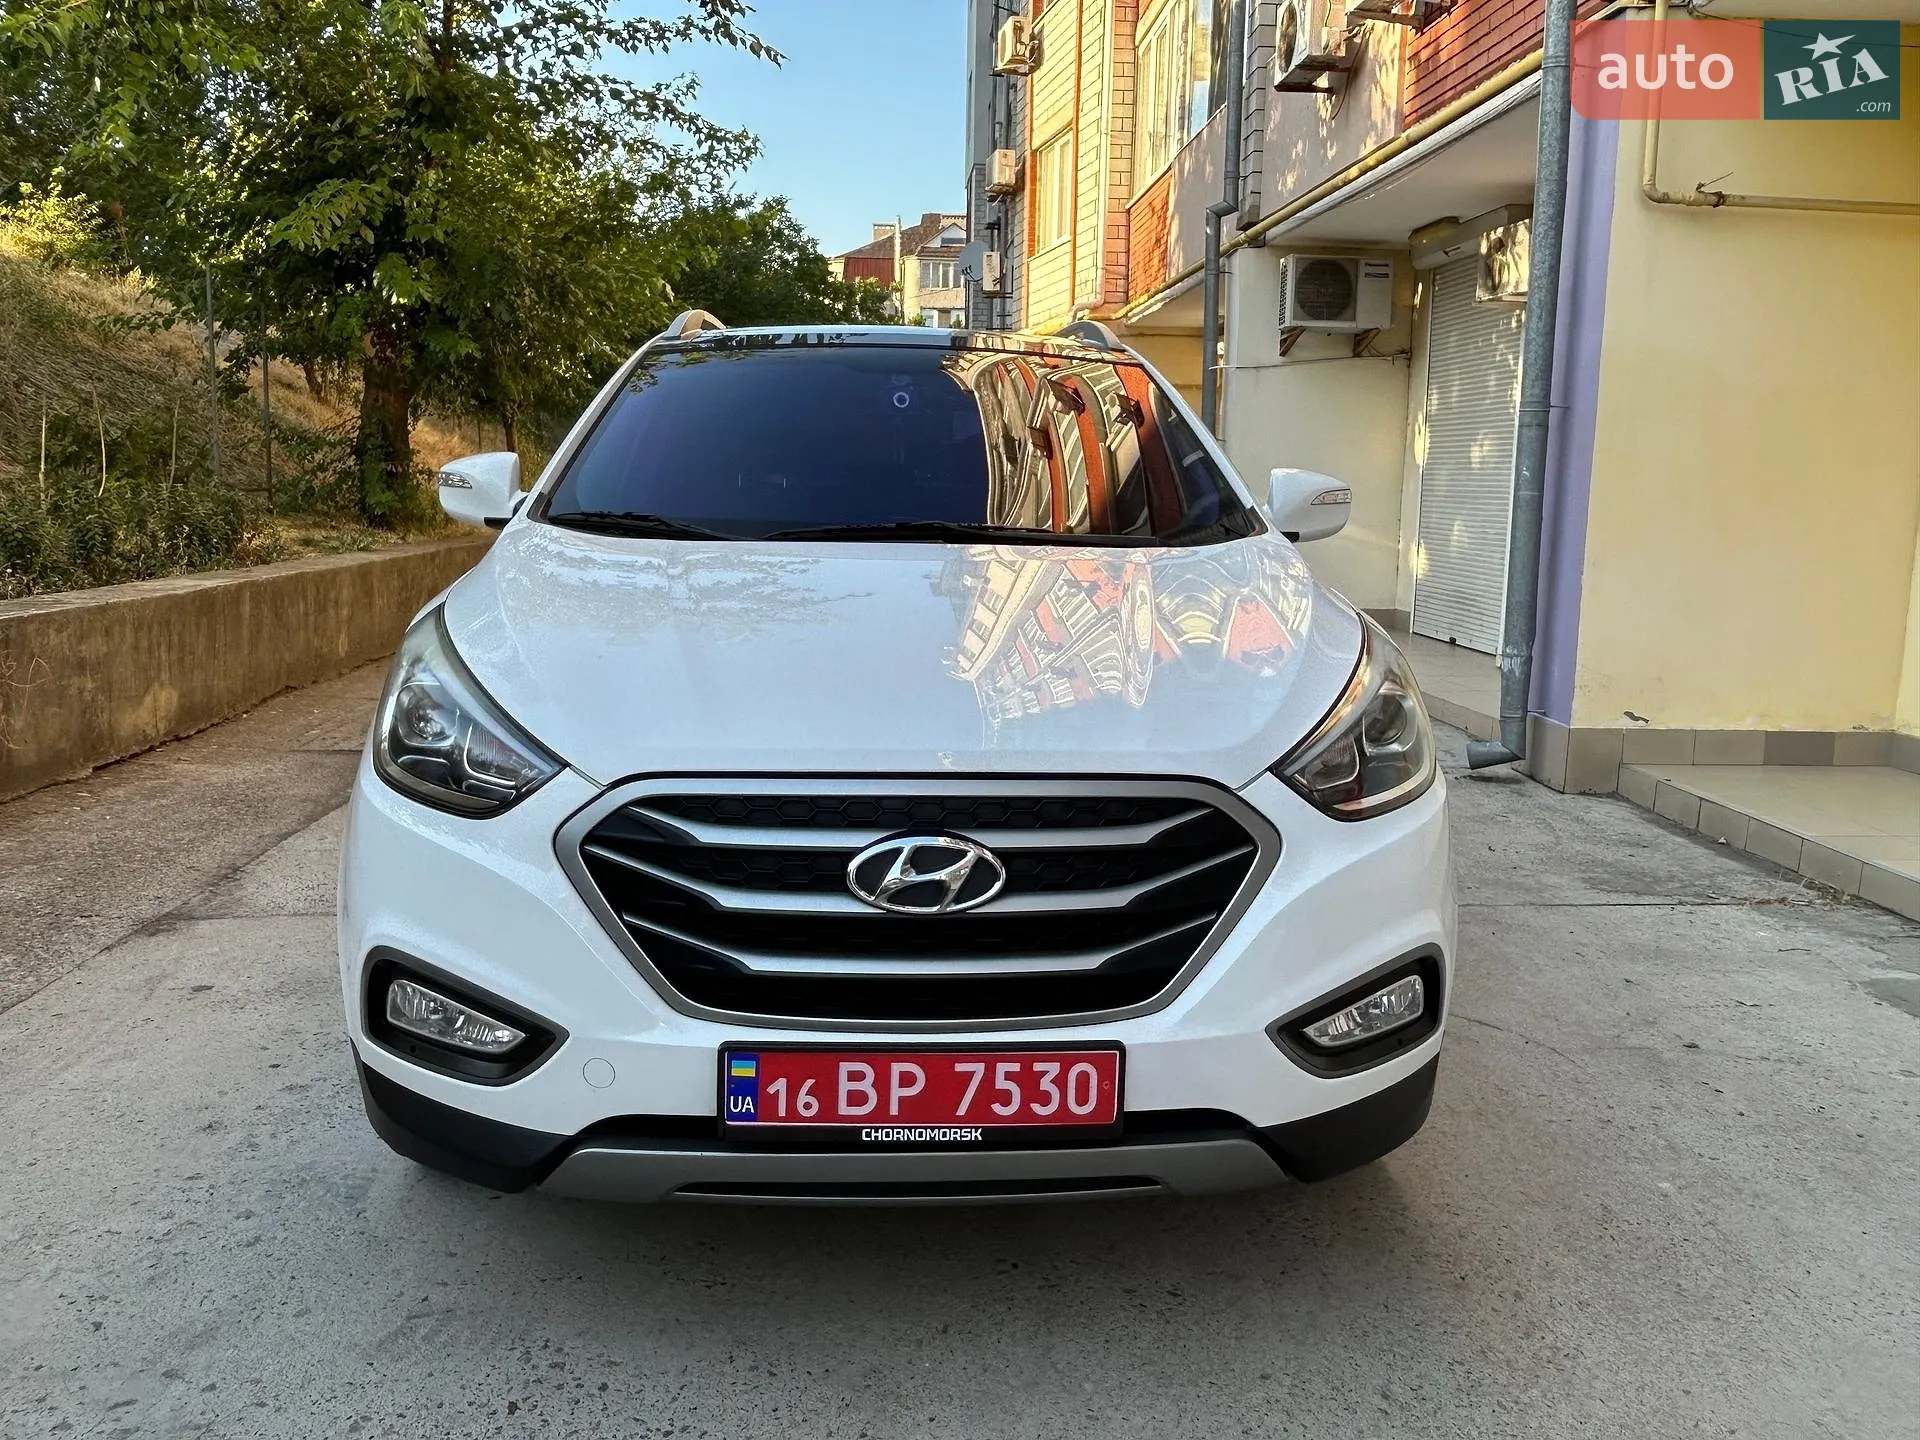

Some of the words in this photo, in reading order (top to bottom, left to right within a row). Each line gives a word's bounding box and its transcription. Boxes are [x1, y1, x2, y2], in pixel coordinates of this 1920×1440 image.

[766, 1077, 820, 1117] 16
[838, 1062, 926, 1116] BP
[954, 1062, 1098, 1116] 7530
[729, 1096, 755, 1114] UA
[861, 1128, 983, 1142] CHORNOMORSK
